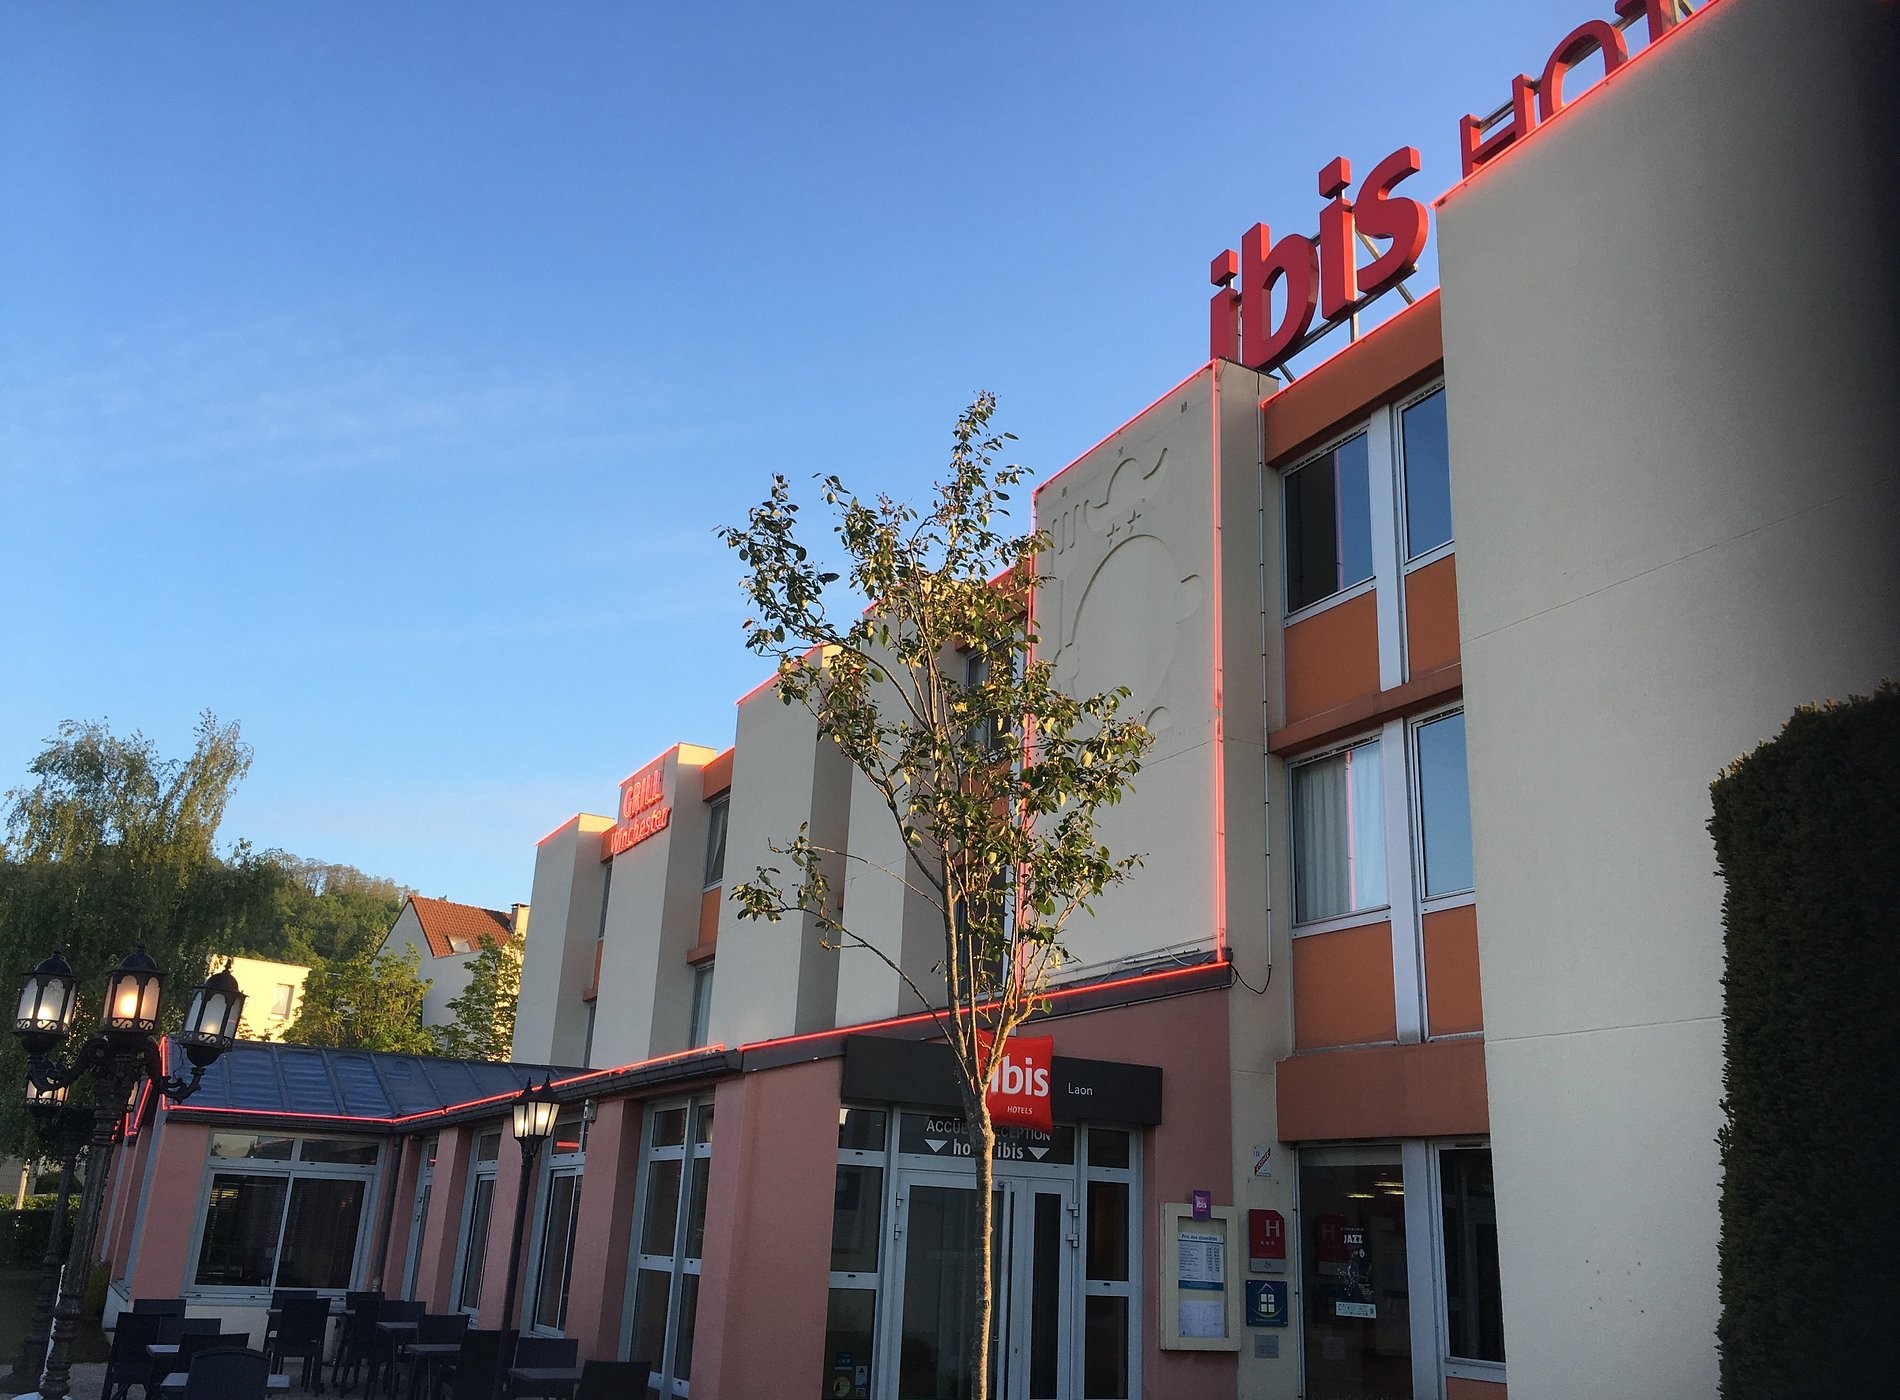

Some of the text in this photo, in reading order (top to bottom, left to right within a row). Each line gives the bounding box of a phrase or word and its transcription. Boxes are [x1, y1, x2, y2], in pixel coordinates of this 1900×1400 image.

[1210, 146, 1429, 371] ibis
[622, 769, 664, 819] GRILL
[1068, 1082, 1093, 1096] Laon
[1007, 1106, 1033, 1115] HOTELS
[997, 1142, 1024, 1160] ibis
[1265, 1220, 1280, 1237] H
[1343, 1234, 1363, 1244] JAZZ
